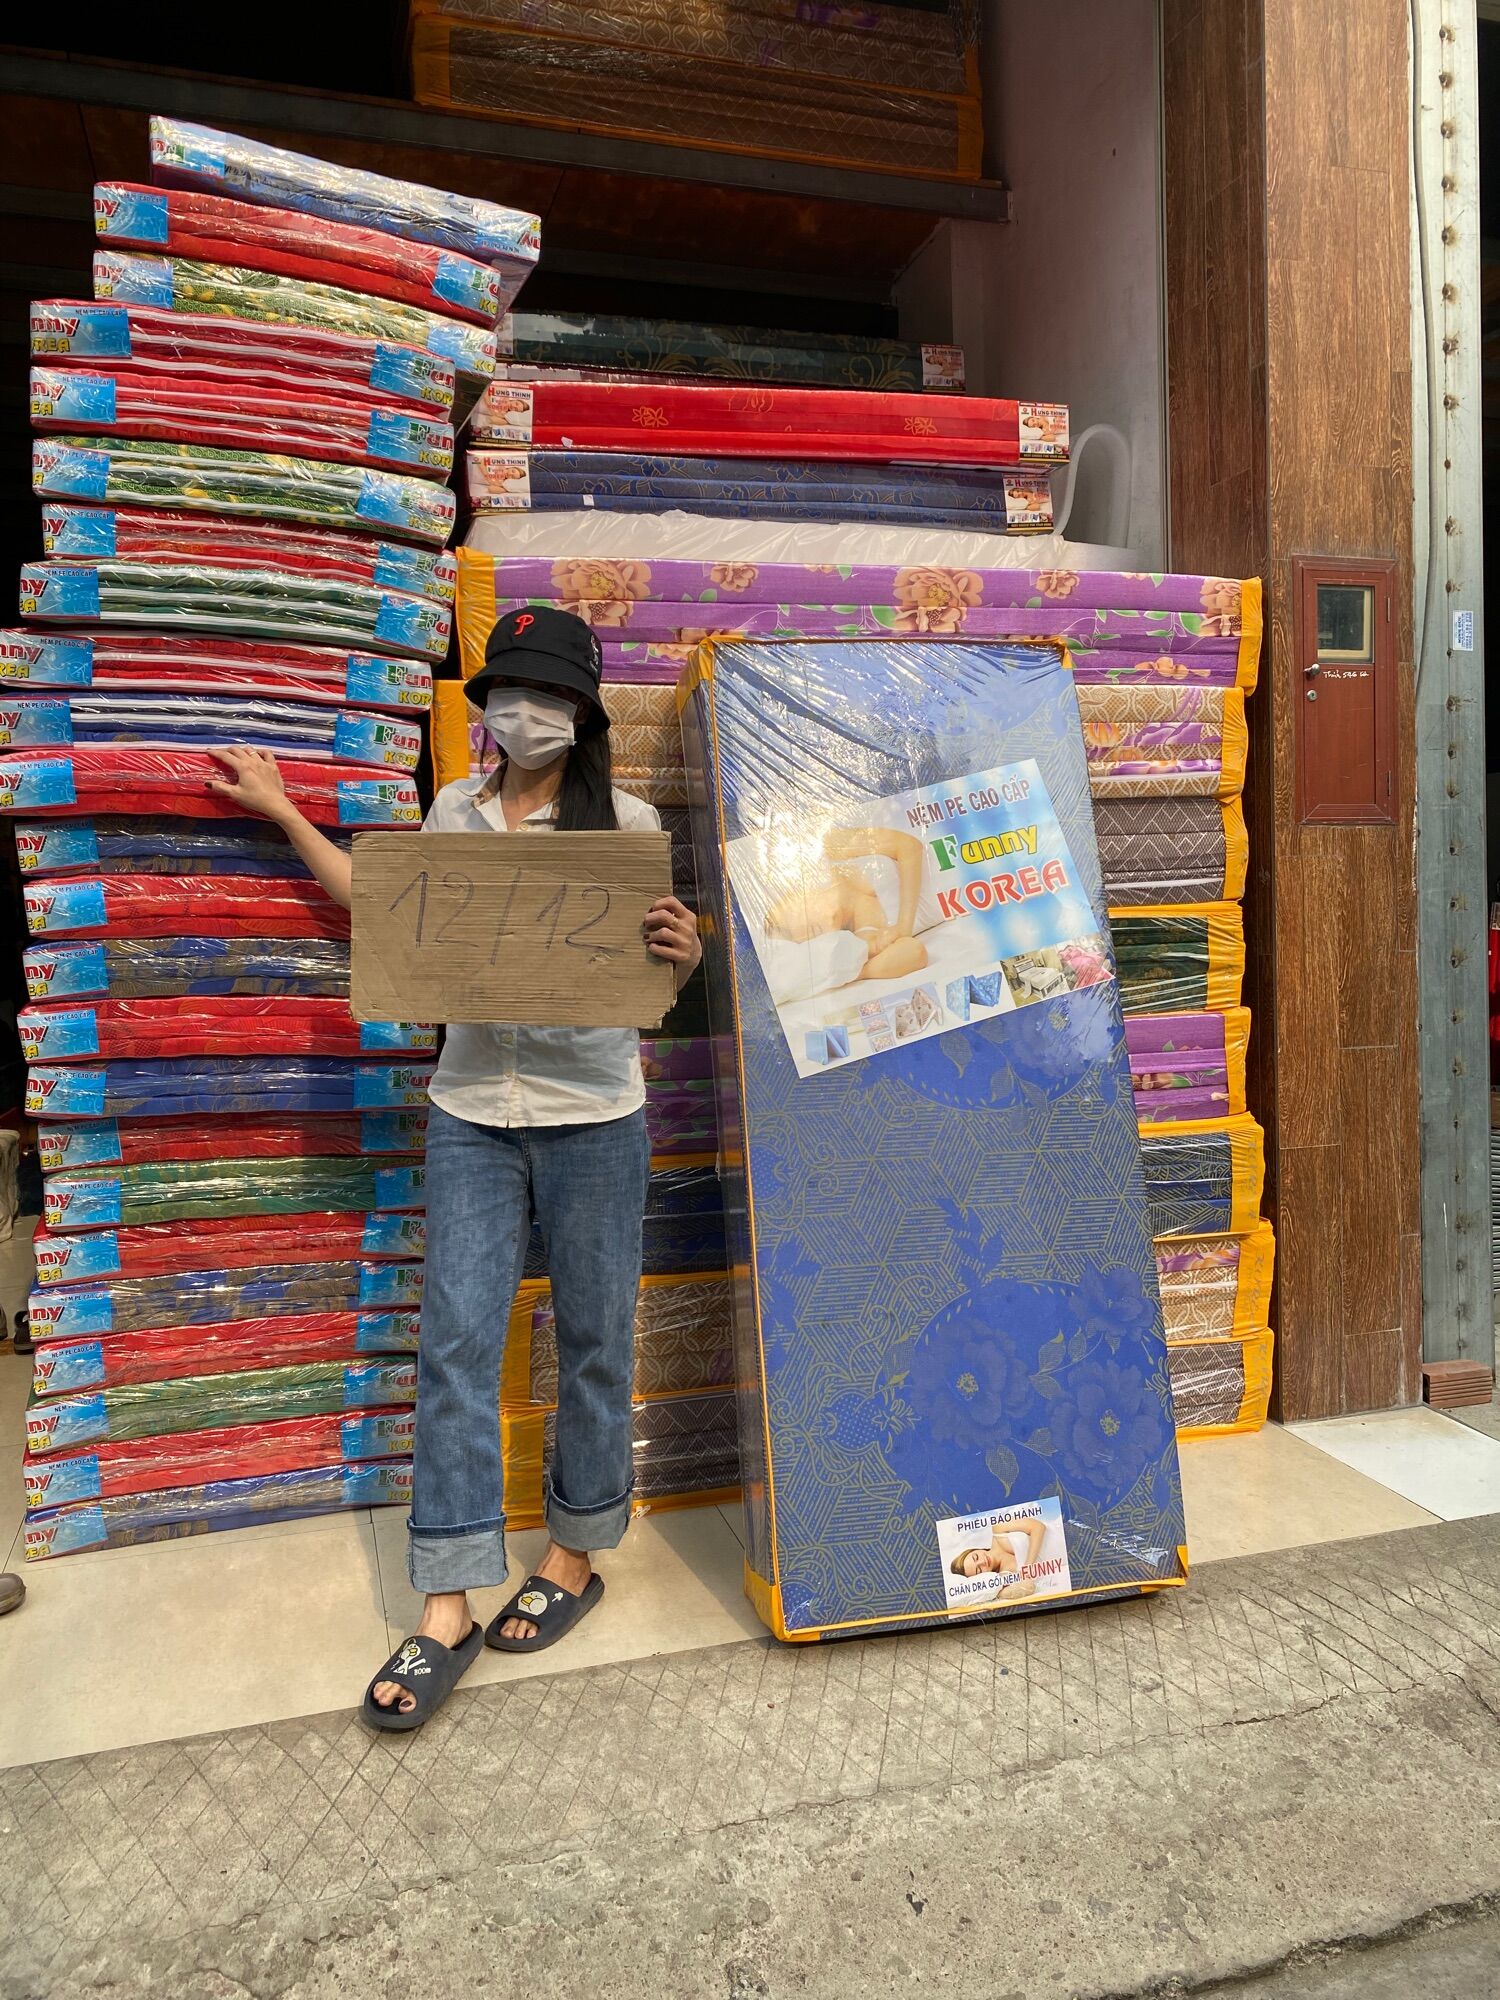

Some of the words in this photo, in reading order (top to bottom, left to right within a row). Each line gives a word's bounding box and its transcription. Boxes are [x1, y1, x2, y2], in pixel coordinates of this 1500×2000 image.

[513, 614, 535, 635] P
[399, 691, 432, 705] KOR
[374, 724, 420, 752] Fun
[384, 750, 418, 769] KOR
[945, 796, 968, 818] PE
[968, 787, 1000, 813] CAO
[1001, 773, 1031, 802] CẤP
[929, 824, 1038, 872] Funny
[936, 859, 1071, 920] KOREA
[25, 962, 57, 981] ny
[27, 1078, 58, 1097] ny
[40, 1134, 72, 1152] ny
[41, 1153, 63, 1168] EA
[45, 1193, 75, 1210] ny
[972, 1581, 987, 1592] DRA
[1021, 1558, 1062, 1580] FUNNY
